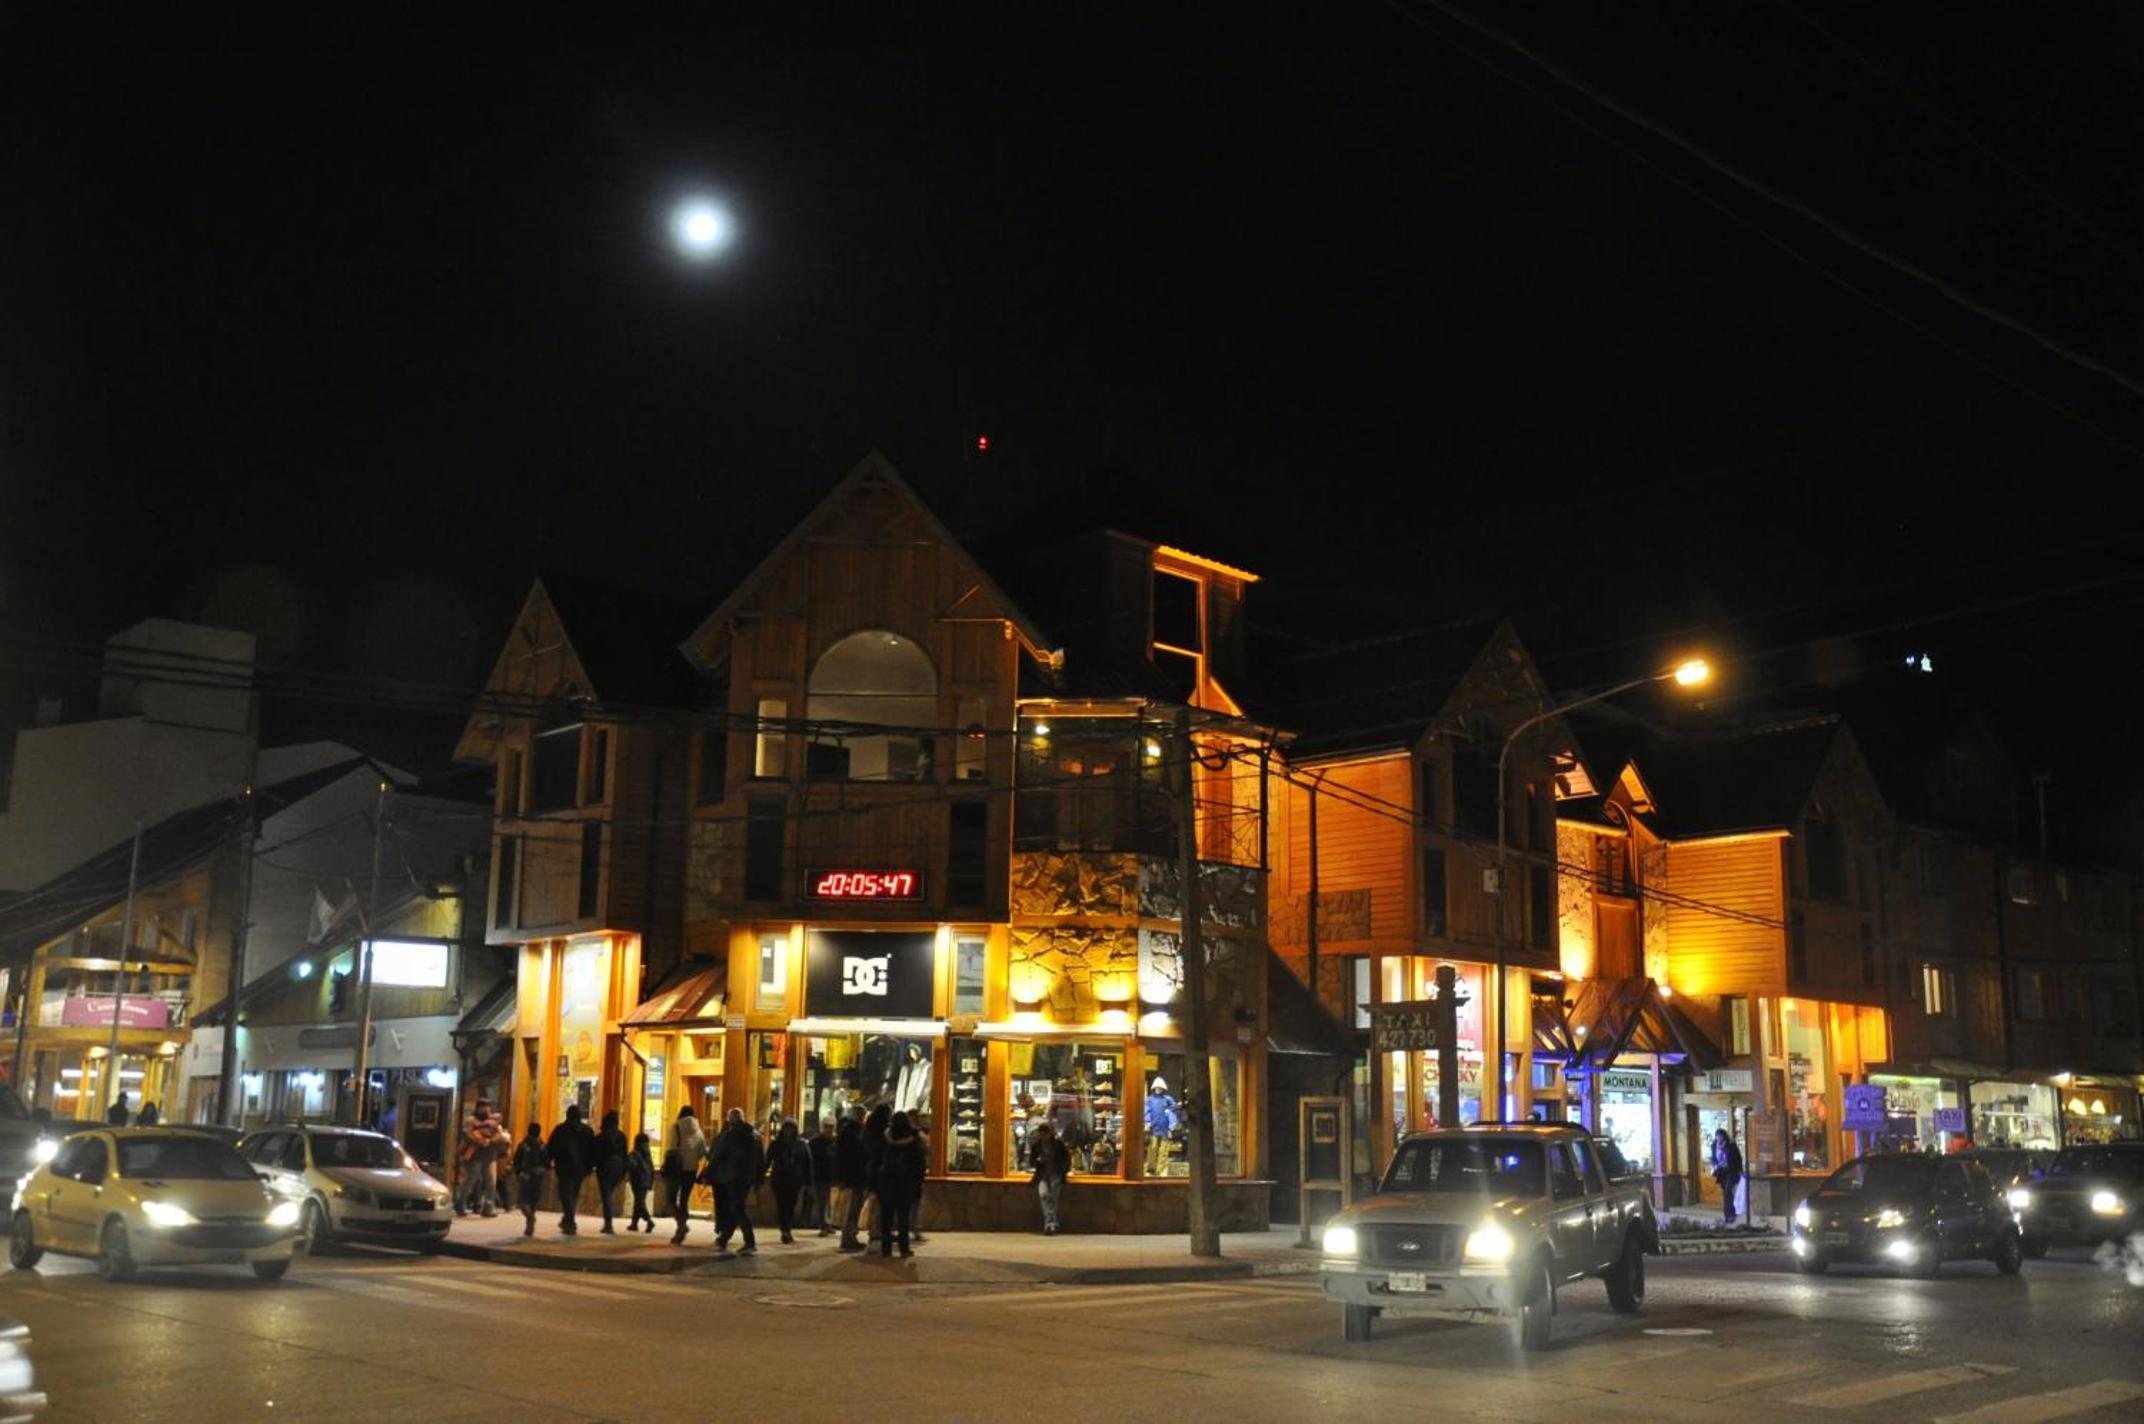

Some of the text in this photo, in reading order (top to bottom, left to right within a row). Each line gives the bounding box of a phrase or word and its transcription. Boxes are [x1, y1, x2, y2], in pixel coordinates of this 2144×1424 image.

[817, 873, 911, 895] 20:05:47
[843, 956, 889, 996] DC
[1383, 1011, 1430, 1028] TAXI
[1379, 1029, 1437, 1048] 427730
[1603, 1076, 1647, 1089] MONTANA
[1937, 1110, 1962, 1120] TAXI
